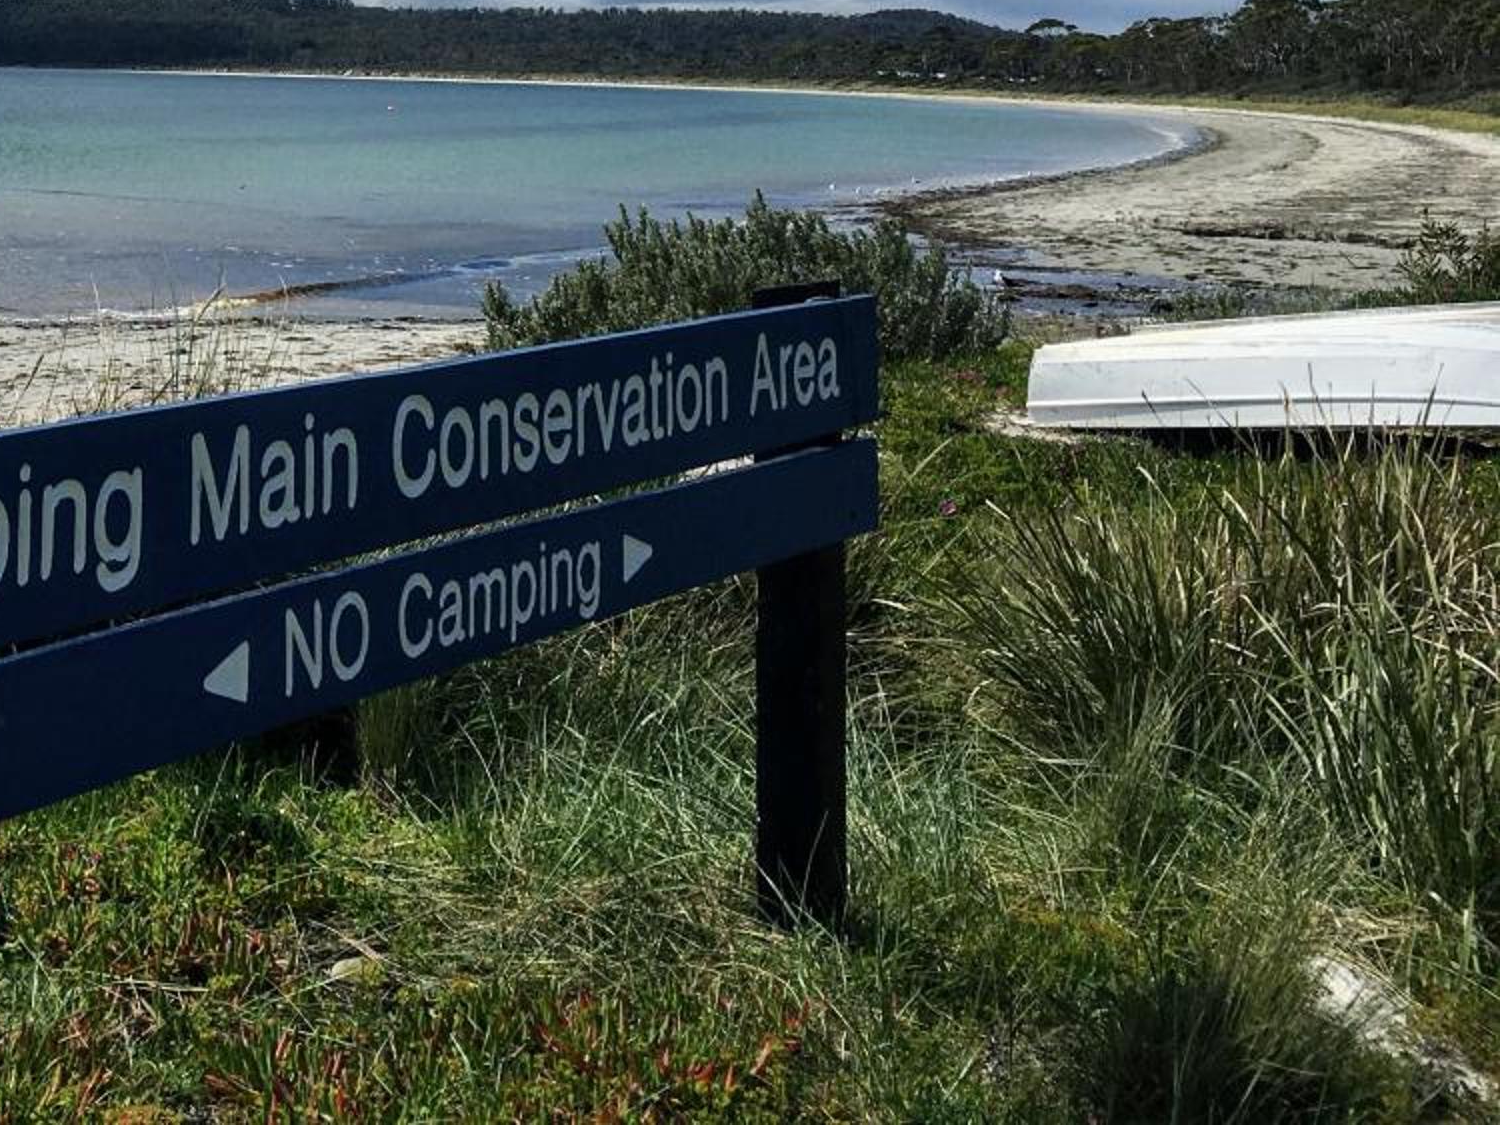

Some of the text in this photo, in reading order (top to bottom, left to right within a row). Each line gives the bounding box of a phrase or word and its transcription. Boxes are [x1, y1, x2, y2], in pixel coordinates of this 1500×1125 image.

[190, 413, 358, 545] Main
[393, 351, 728, 498] Conservation
[750, 333, 840, 416] Area
[285, 537, 601, 697] NO Camping
